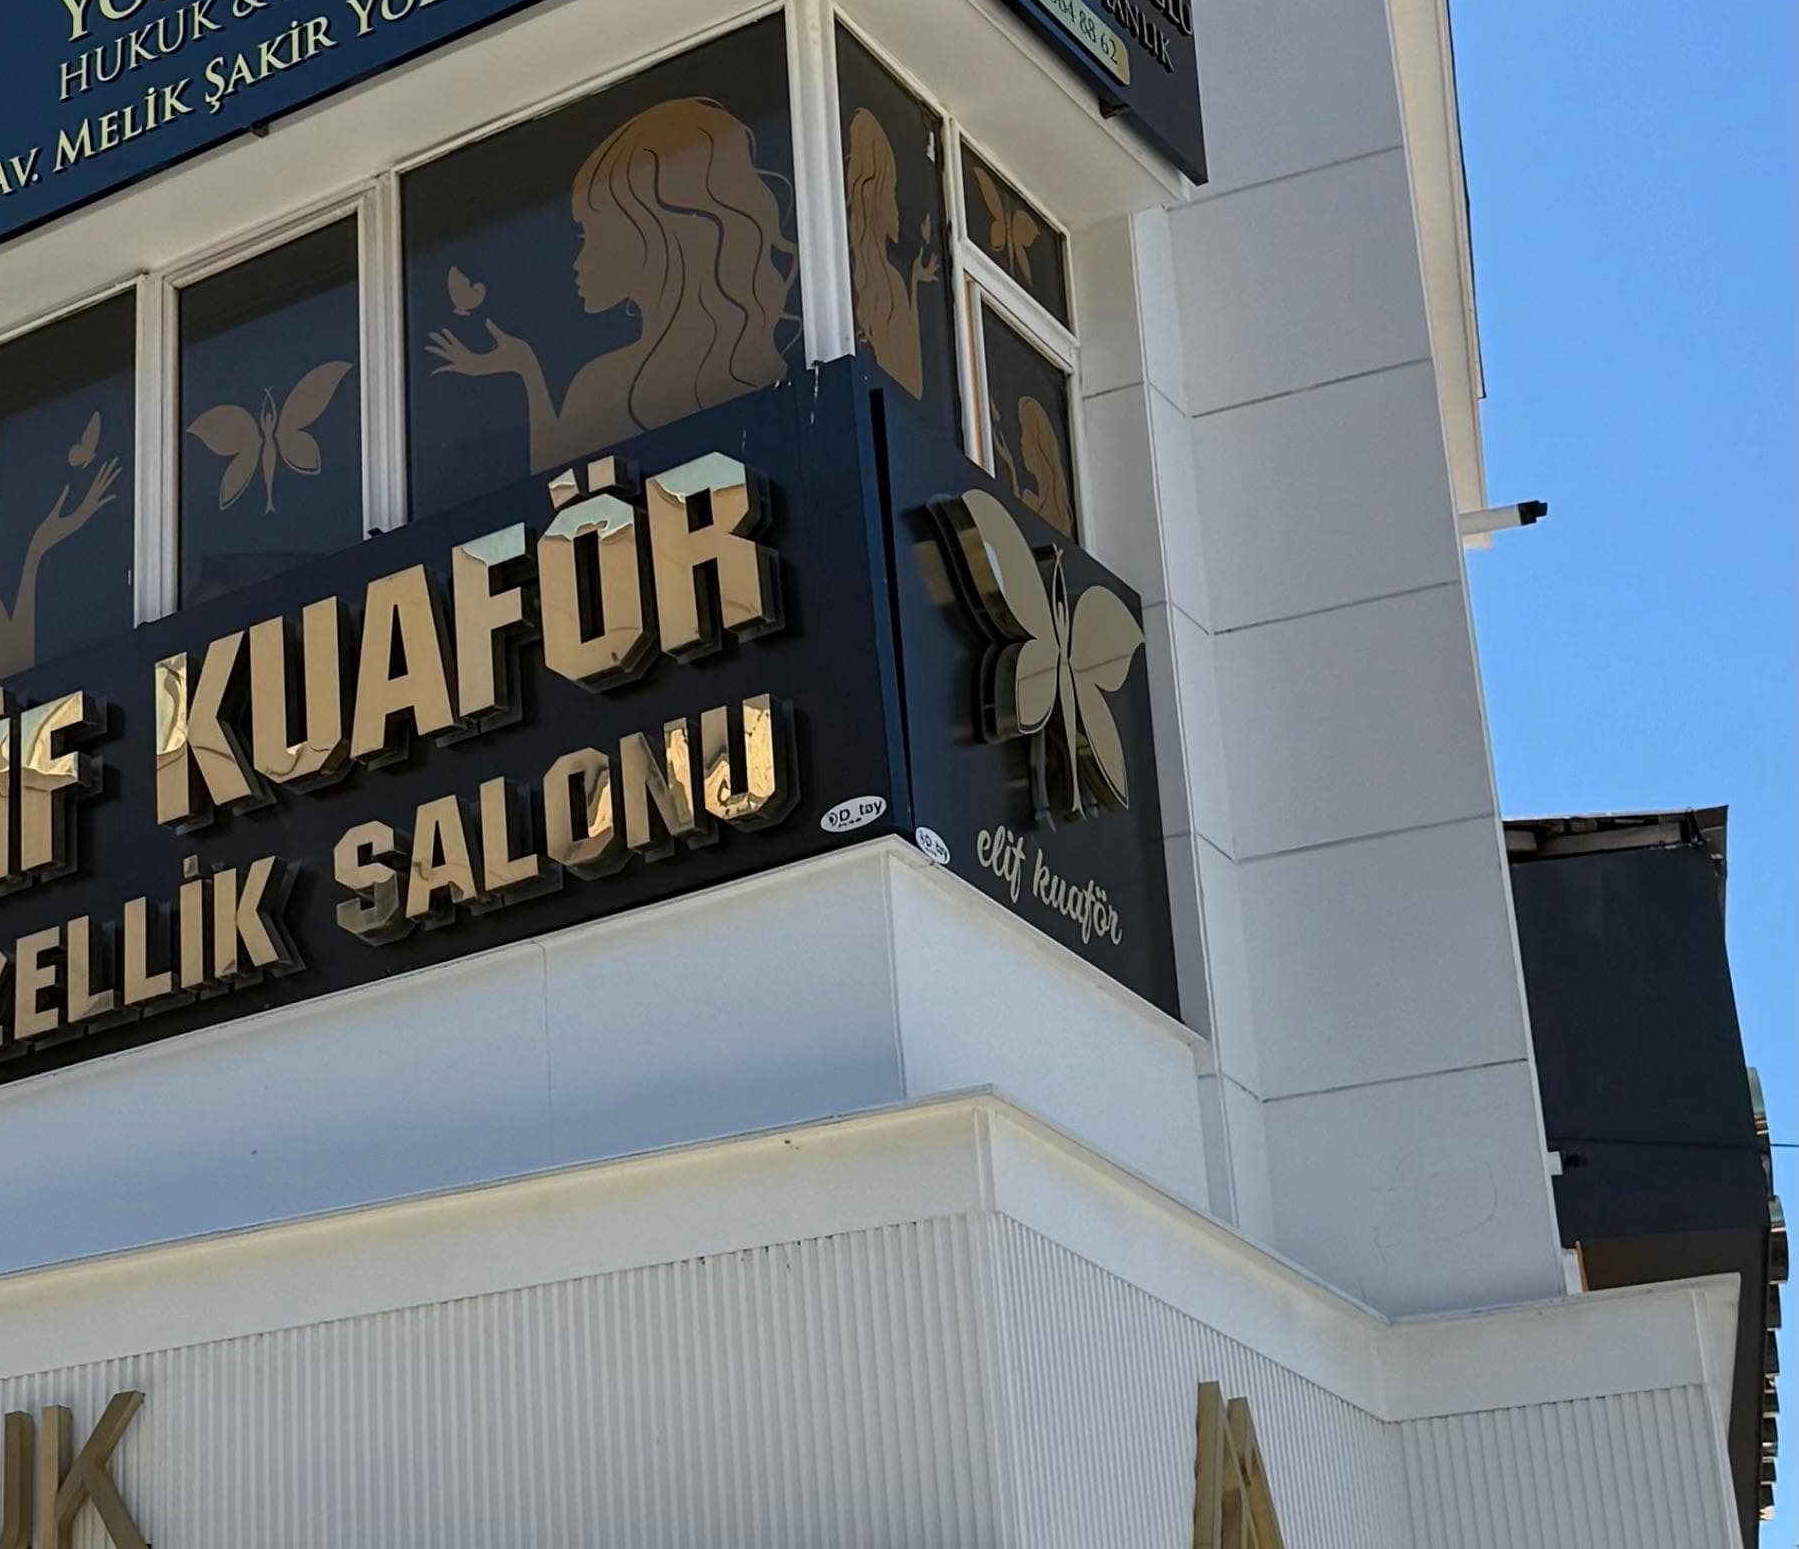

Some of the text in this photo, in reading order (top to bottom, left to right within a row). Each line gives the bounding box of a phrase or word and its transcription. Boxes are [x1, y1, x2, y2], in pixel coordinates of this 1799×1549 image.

[53, 77, 193, 173] MELİK
[204, 16, 338, 112] ŞAKİR
[1080, 11, 1096, 43] 88
[1101, 33, 1118, 64] 62
[154, 451, 770, 826] KUAFÖR
[333, 693, 782, 946] SALONU
[976, 825, 1026, 903] elif
[1032, 847, 1122, 945] kuaför
